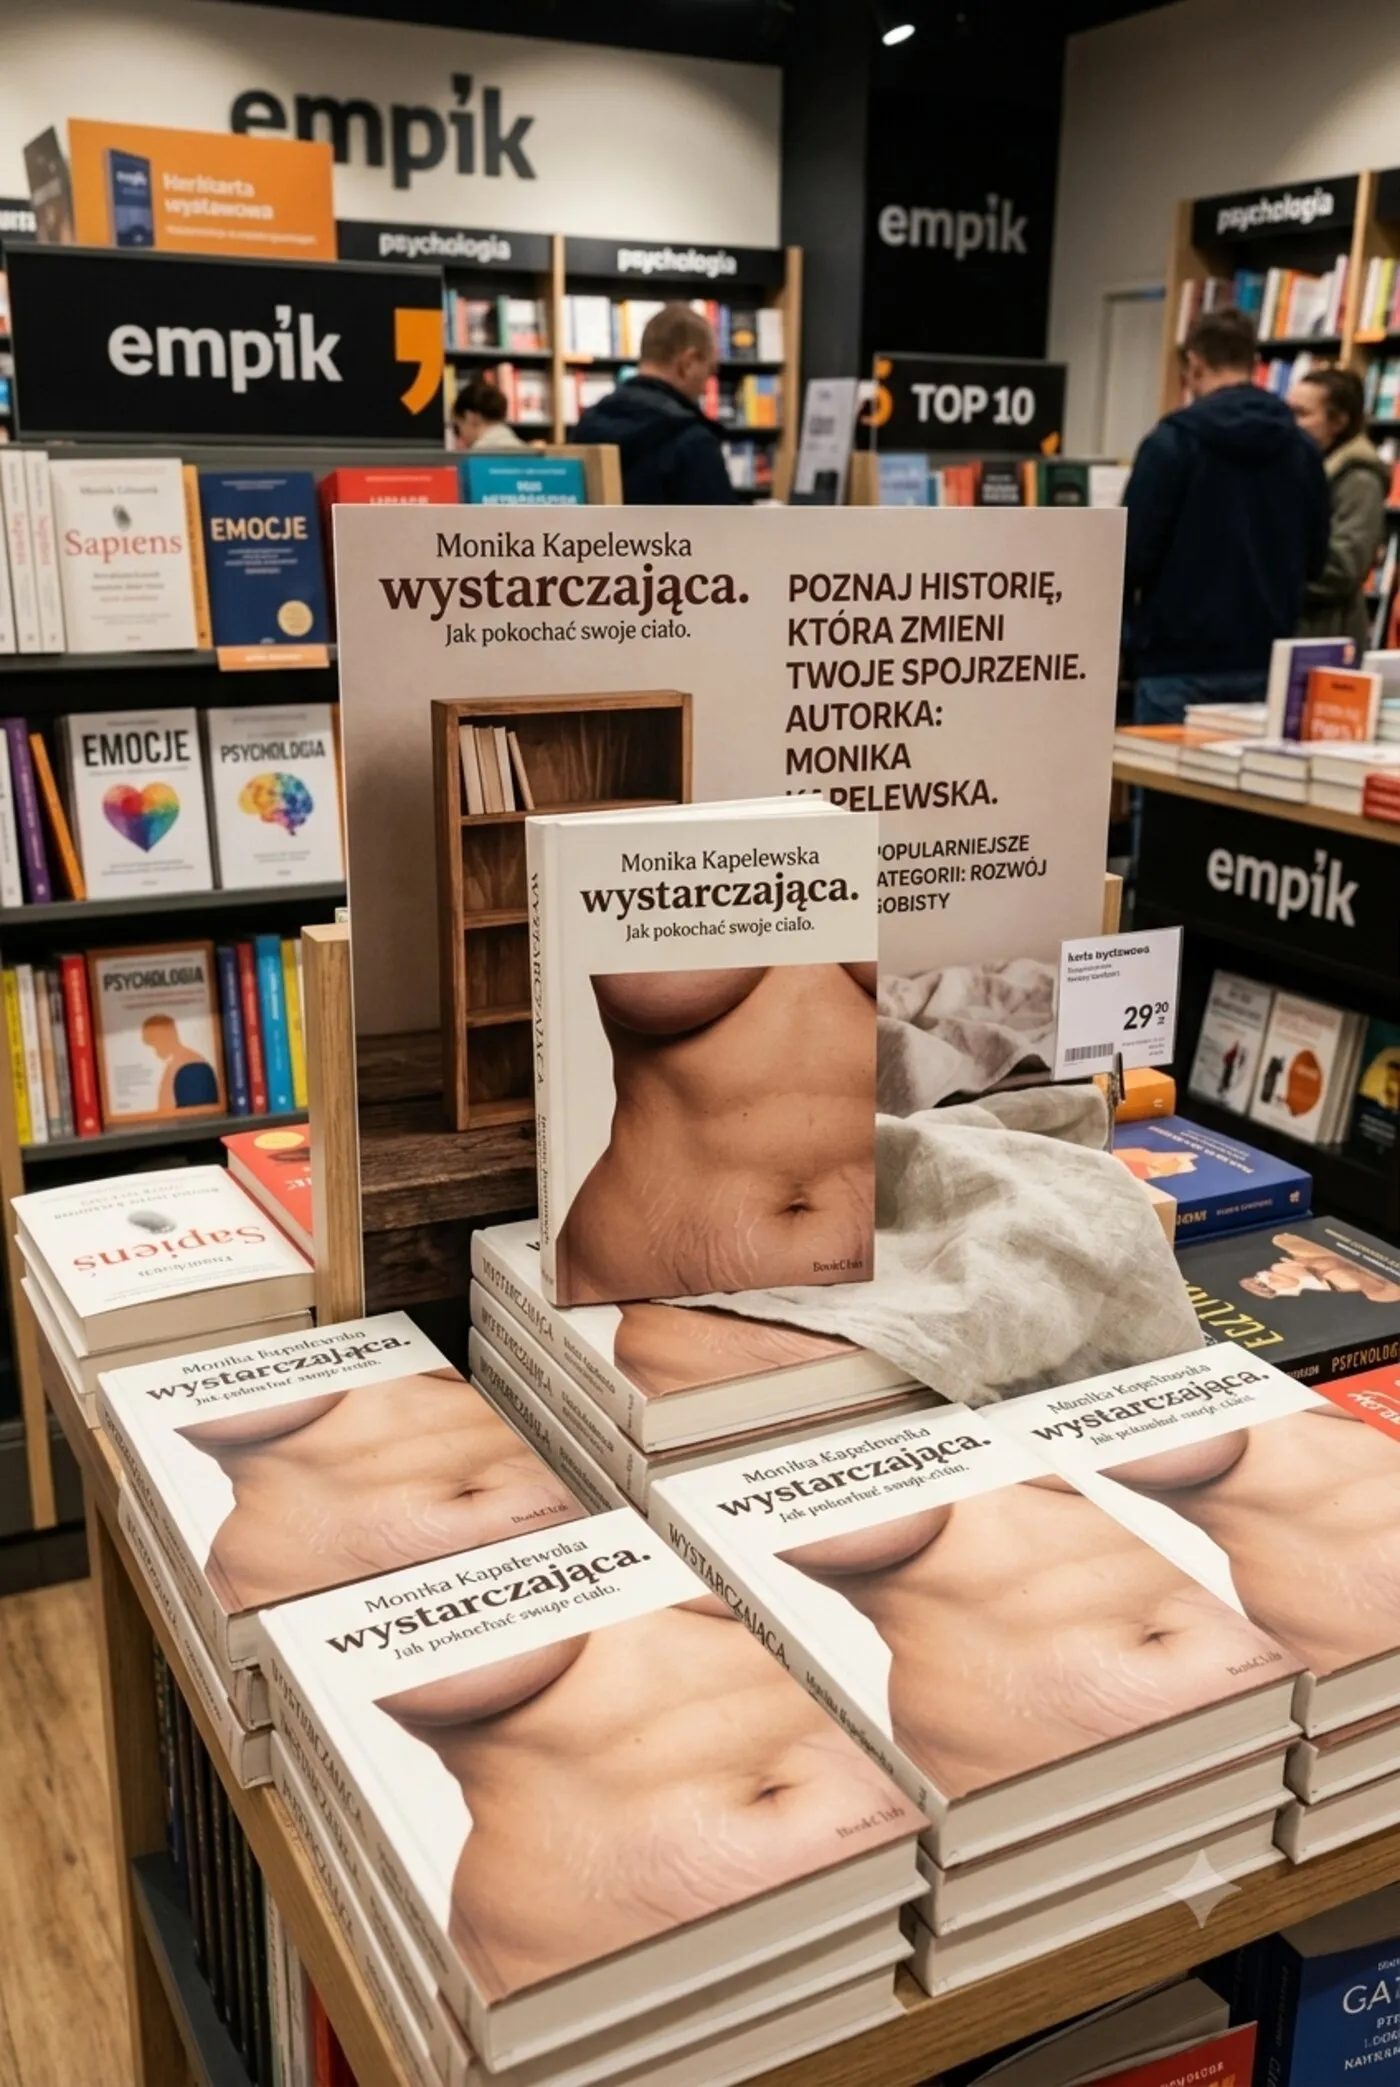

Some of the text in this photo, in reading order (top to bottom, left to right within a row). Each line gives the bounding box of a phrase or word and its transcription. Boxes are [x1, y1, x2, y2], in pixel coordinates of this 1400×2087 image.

[230, 73, 537, 190] empik
[878, 192, 1029, 262] empik
[1216, 186, 1335, 236] psychologia
[378, 232, 512, 264] psychologia
[616, 247, 738, 278] psychologia
[107, 305, 344, 394] empik
[911, 383, 1036, 425] TOP 10
[64, 528, 183, 565] Sapiens
[210, 515, 309, 542] EMOCJE
[436, 531, 693, 564] Monika Kapelewska
[379, 563, 750, 622] wystarczająca.
[789, 570, 1063, 606] POZNAJ HISTORIĘ,
[445, 620, 692, 648] Jak pokochać swoje ciało.
[788, 609, 1005, 647] KTÓRA ZMIENI
[786, 653, 1087, 689] TWOJE SPOJRZENIE.
[785, 700, 944, 733] AUTORKA:
[81, 729, 191, 768] EMOCJE
[785, 743, 912, 775] MONIKA
[786, 778, 999, 813] PELEWSKA.
[621, 846, 820, 876] Monika Kapelewska
[877, 834, 1030, 862] OPULARNIEJSZE
[877, 856, 1048, 888] ATEGORII: ROZWÓJ
[1206, 847, 1360, 928] empik
[580, 871, 860, 921] wystarczająca.
[626, 916, 815, 943] Jak pokochać swoje ciało.
[1123, 1003, 1153, 1031] 29
[72, 1225, 267, 1270] Sapiens
[145, 1334, 412, 1401] wystarczająca.
[1030, 1369, 1271, 1441] wystarczająca.
[716, 1433, 993, 1518] wystarczająca.
[324, 1549, 653, 1655] wystarczająca.
[1342, 1979, 1400, 2014] GA
